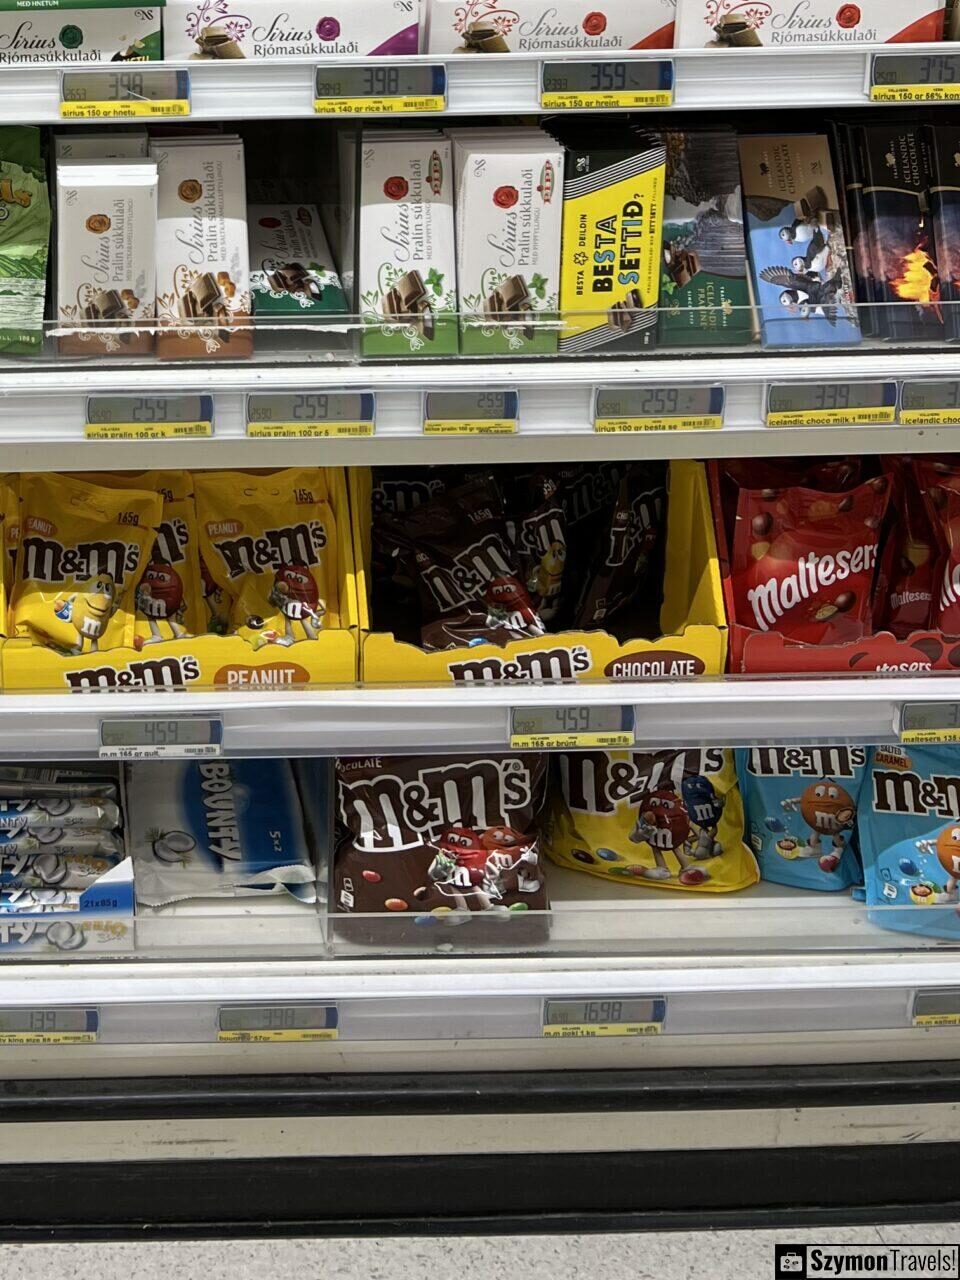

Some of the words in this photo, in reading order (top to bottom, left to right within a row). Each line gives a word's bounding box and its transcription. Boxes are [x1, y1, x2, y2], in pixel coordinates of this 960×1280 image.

[16, 0, 32, 8] MEÐ
[35, 0, 59, 7] HNETUM
[518, 35, 623, 51] Rjómasúkkulaði
[771, 28, 877, 45] Rjómasúkkulaði
[254, 40, 358, 58] Rjómasúkkulaði
[363, 68, 398, 95] 398
[591, 63, 626, 90] 359
[596, 99, 619, 107] hreint
[578, 213, 588, 253] DEILDIN
[592, 214, 618, 293] BESTA
[575, 270, 585, 296] BESTA
[293, 394, 328, 418] 259
[642, 389, 677, 413] 259
[618, 424, 632, 432] 100
[207, 521, 241, 537] PEANUT
[227, 668, 296, 686] PEANUT
[612, 659, 696, 679] CHOCOLATE
[556, 707, 589, 730] 459
[144, 722, 178, 743] 459
[198, 759, 241, 862] BOUNTY
[585, 1002, 622, 1021] 1698
